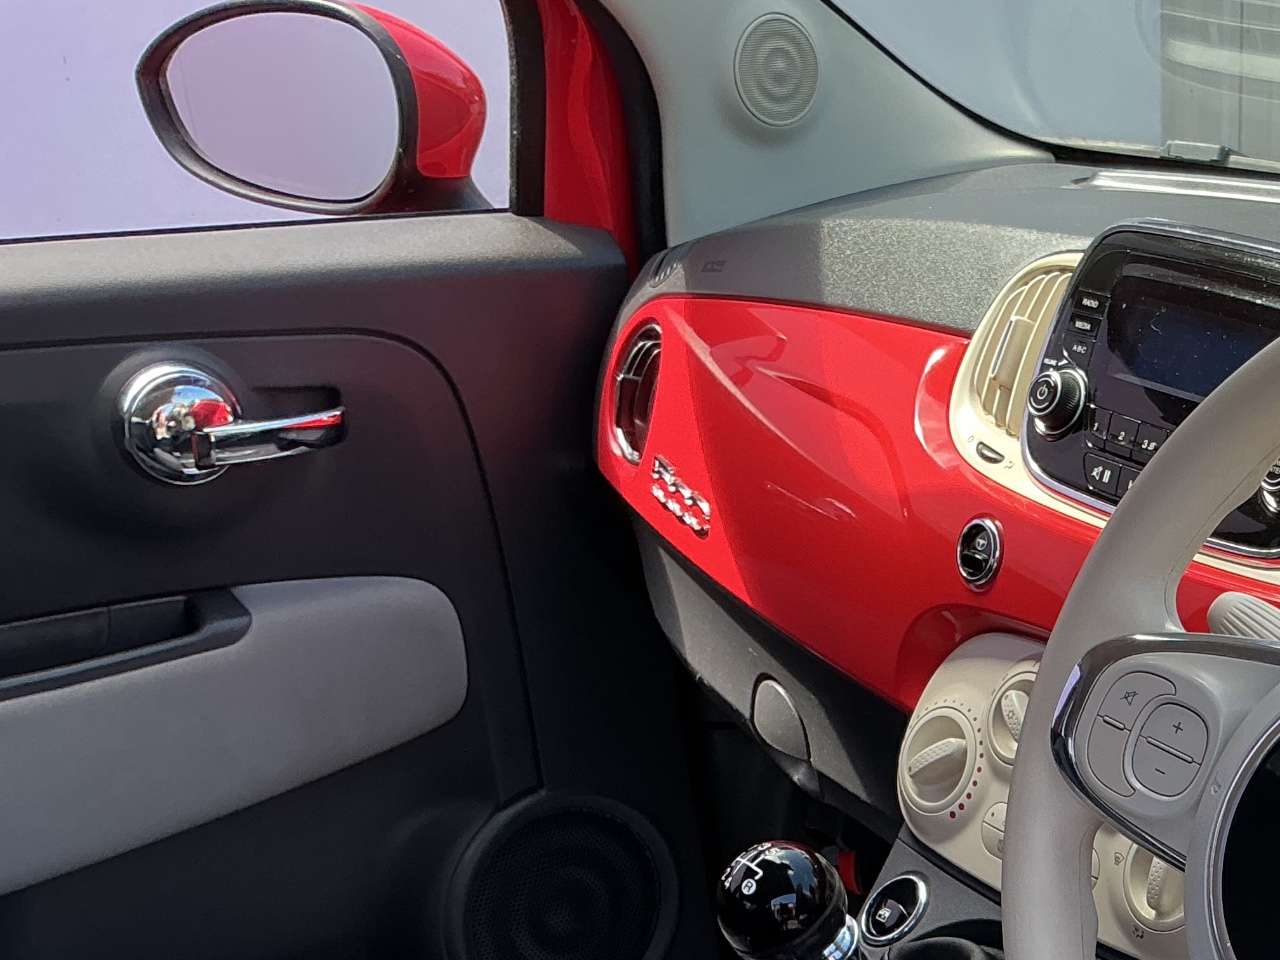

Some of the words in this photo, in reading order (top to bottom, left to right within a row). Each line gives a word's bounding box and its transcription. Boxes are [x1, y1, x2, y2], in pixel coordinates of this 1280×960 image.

[1081, 299, 1099, 309] RADIO
[1092, 422, 1099, 431] 1
[1118, 431, 1126, 440] 2
[1141, 439, 1149, 449] 3
